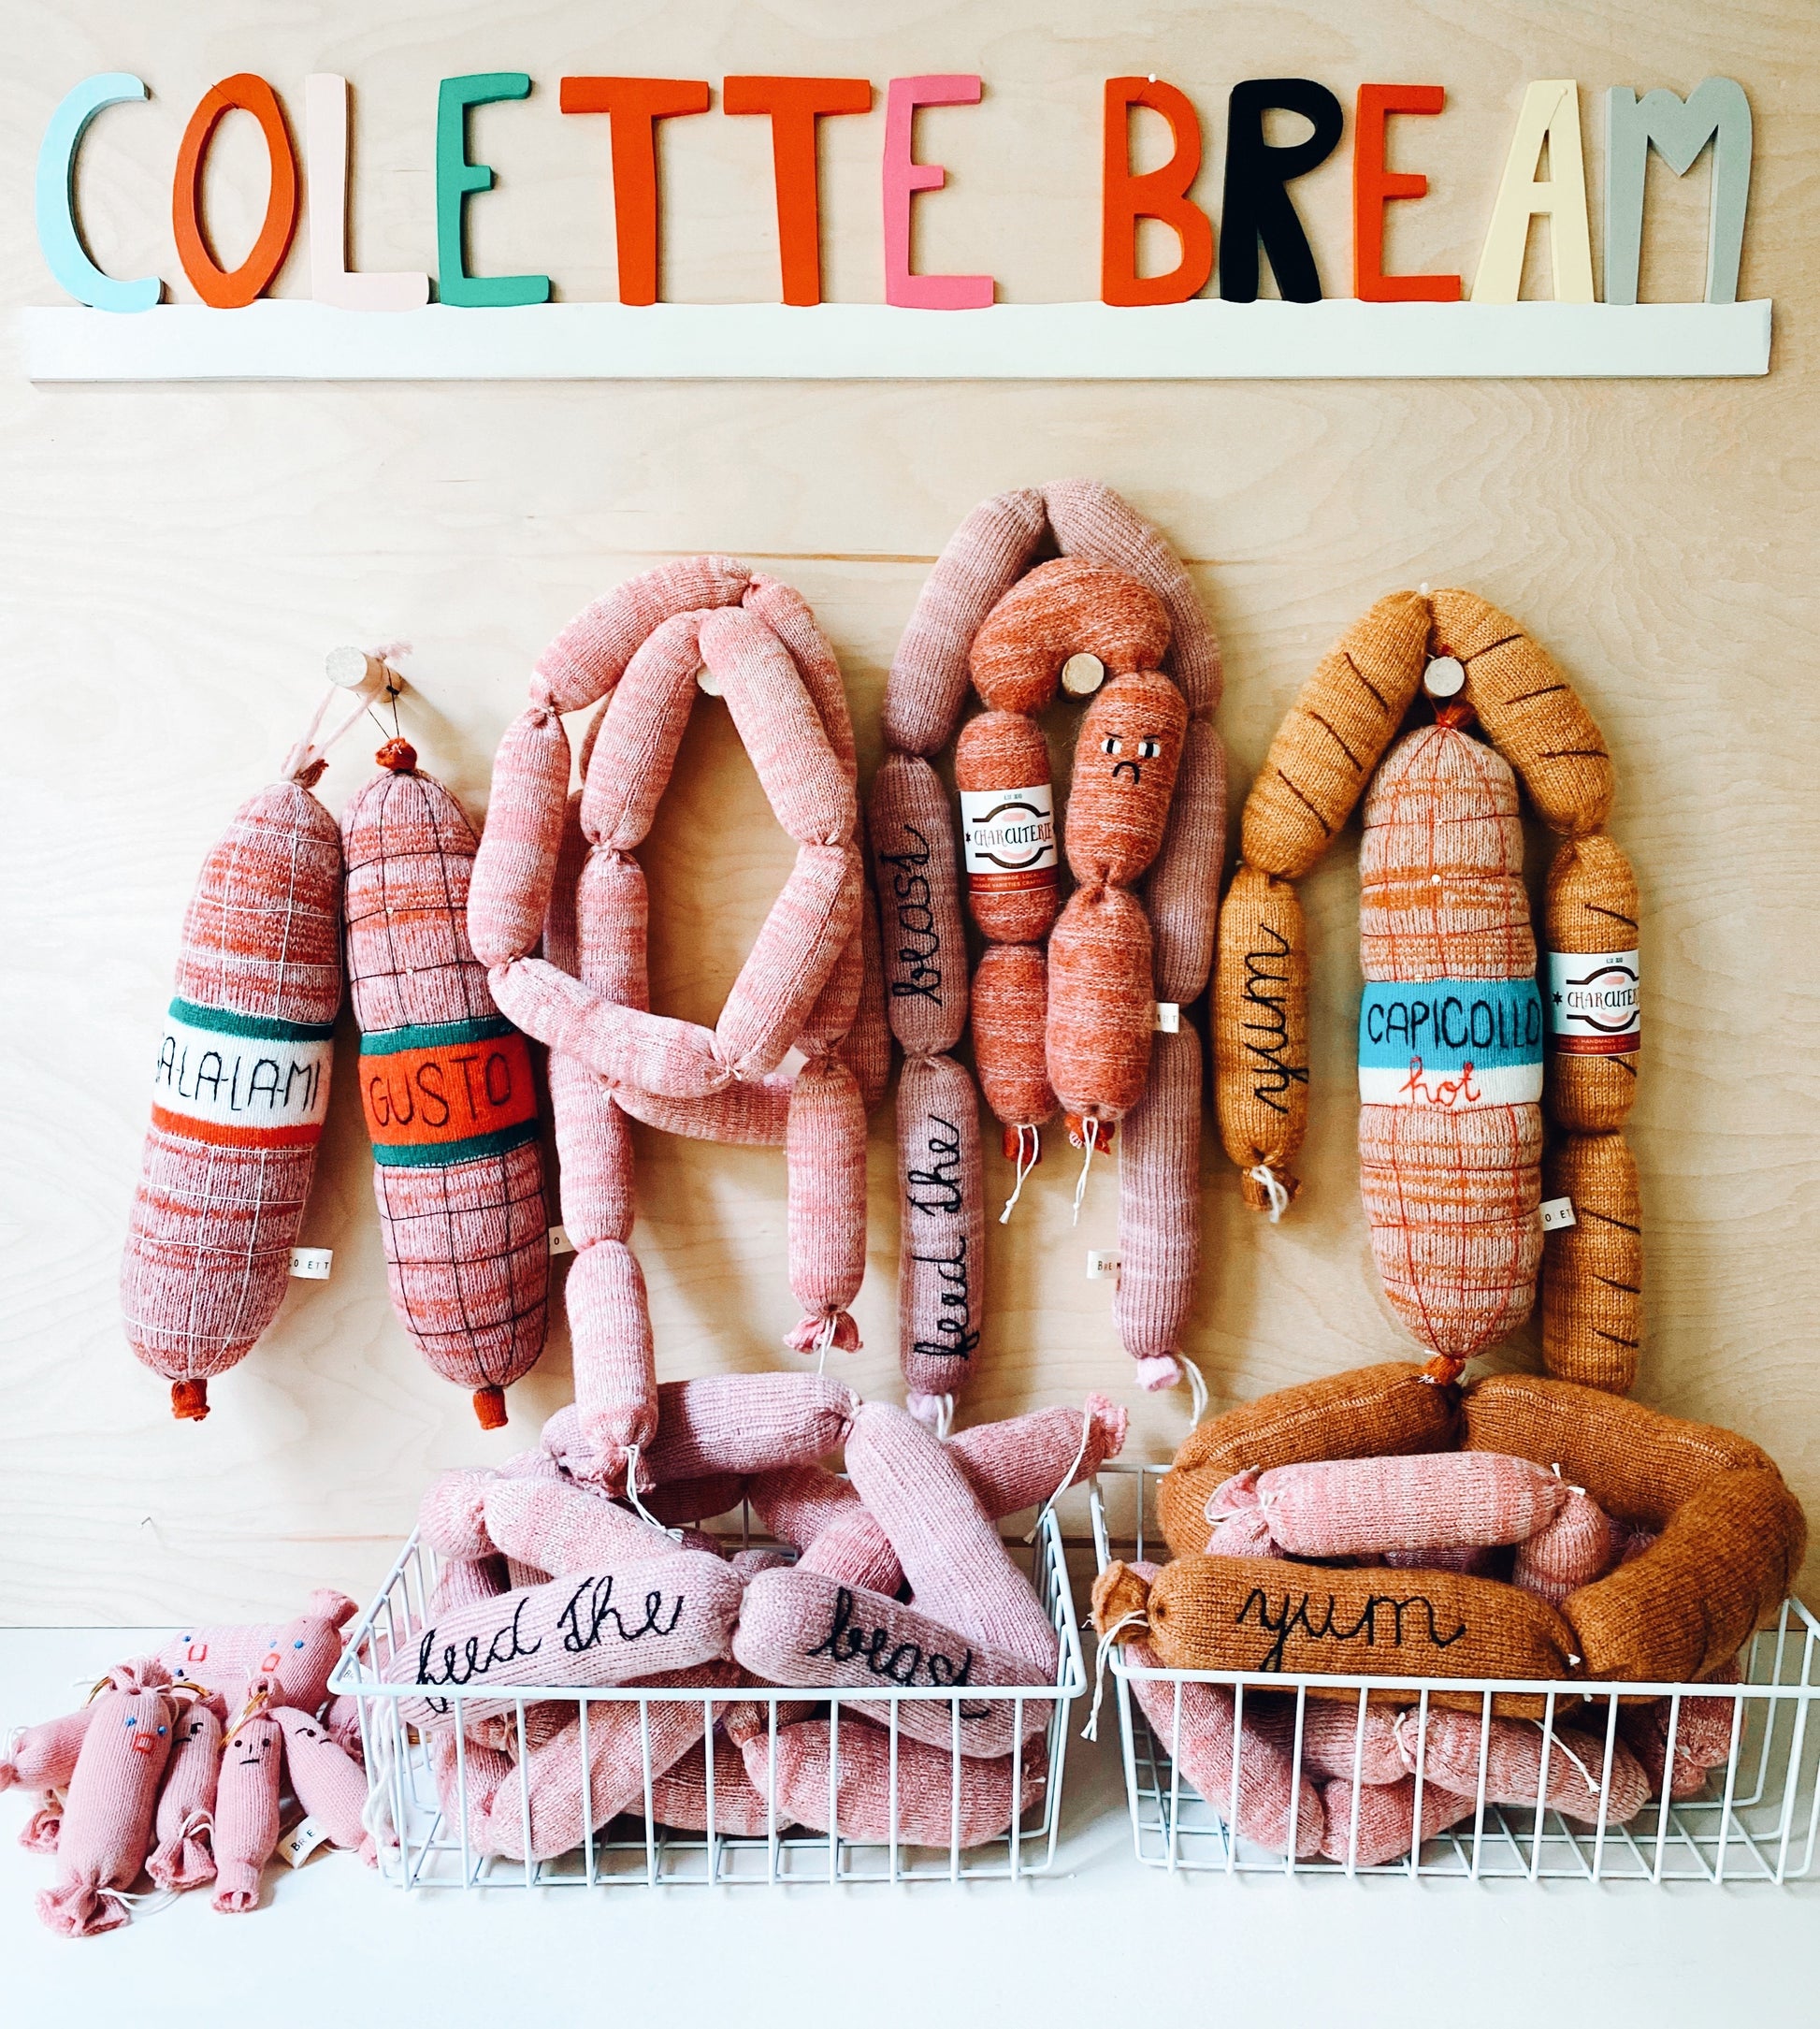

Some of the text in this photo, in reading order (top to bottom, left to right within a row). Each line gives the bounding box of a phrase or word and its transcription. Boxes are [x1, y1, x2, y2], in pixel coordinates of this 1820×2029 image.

[36, 73, 1754, 312] COLETTE BREAM
[974, 822, 1052, 848] CHARCUTERIE
[880, 824, 944, 1007] beast
[1242, 922, 1309, 1114] yum
[1367, 996, 1540, 1050] CAPICOLLO
[156, 1033, 321, 1111] A-LA-LA-MI
[368, 1051, 512, 1128] GUSTO
[1398, 1055, 1481, 1107] hot
[913, 1235, 979, 1362] feed
[415, 1597, 542, 1714] feed
[1237, 1588, 1467, 1673] yum
